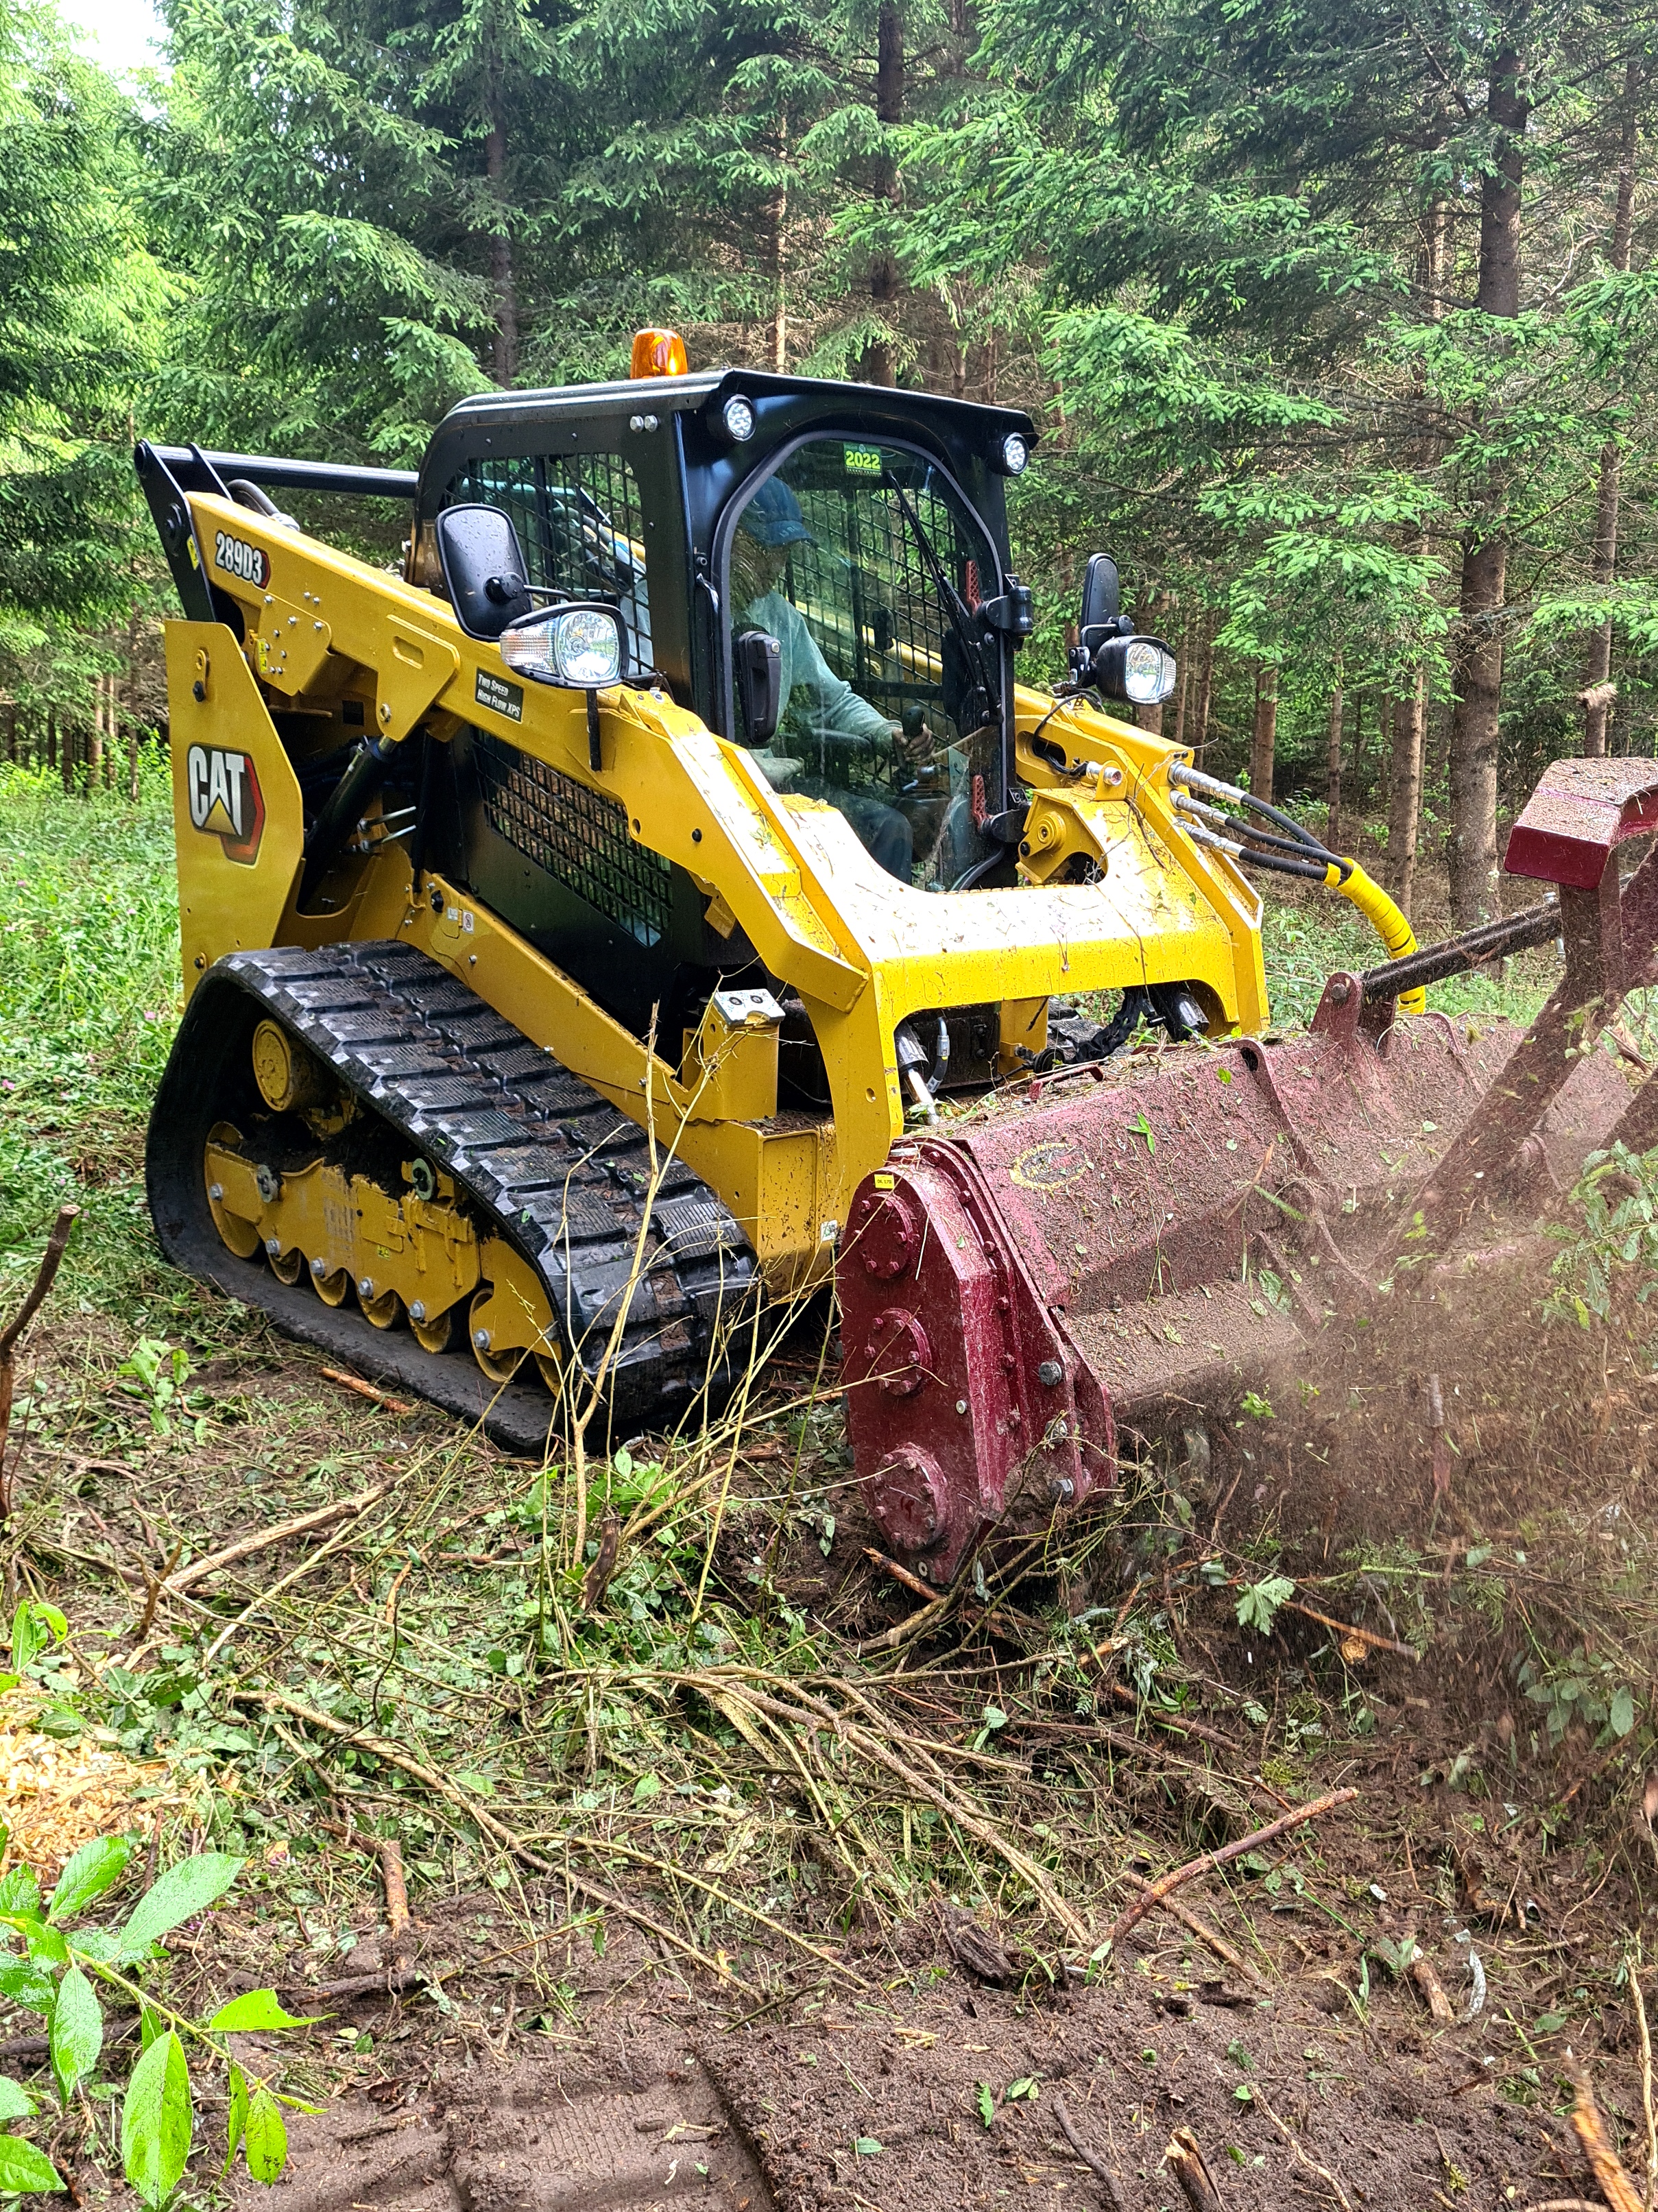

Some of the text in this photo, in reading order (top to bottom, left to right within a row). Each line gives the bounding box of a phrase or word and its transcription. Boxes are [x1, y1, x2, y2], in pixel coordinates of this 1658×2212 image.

[845, 450, 881, 470] 2022
[216, 531, 263, 584] 289D3
[506, 701, 521, 718] XPS
[189, 745, 245, 837] CAT
